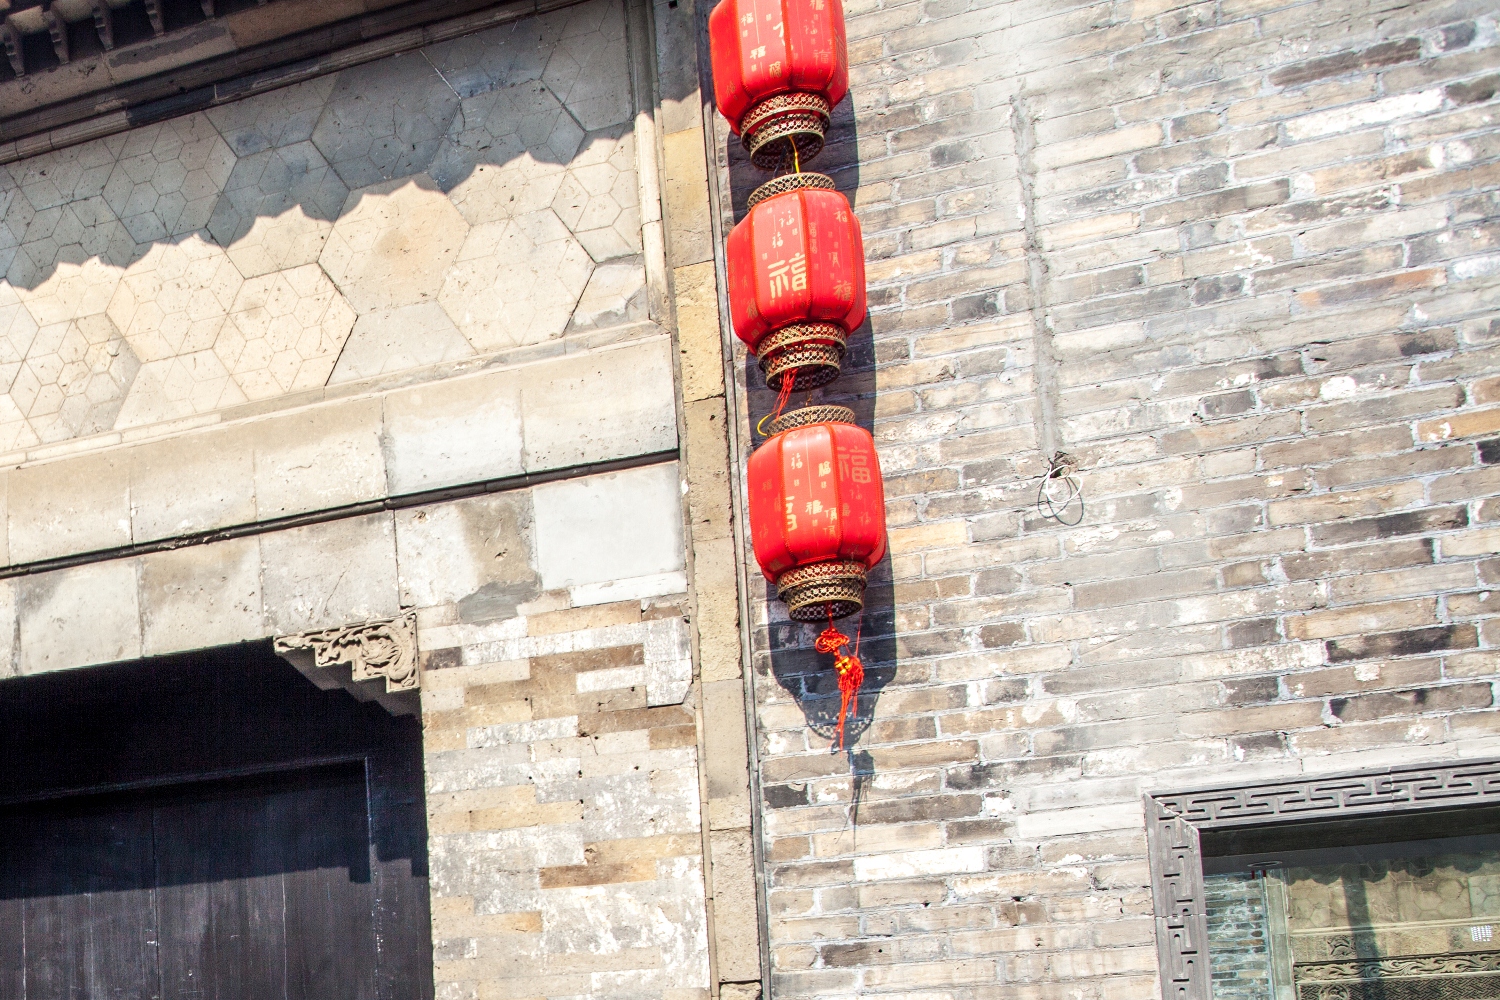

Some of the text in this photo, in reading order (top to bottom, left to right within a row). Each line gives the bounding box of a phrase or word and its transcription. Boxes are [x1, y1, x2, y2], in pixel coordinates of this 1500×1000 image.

[750, 46, 765, 60] 福
[779, 210, 795, 228] 福
[772, 232, 784, 249] 福
[767, 252, 807, 299] 福
[791, 453, 803, 470] 福
[837, 446, 872, 484] 福
[805, 500, 823, 515] 福
